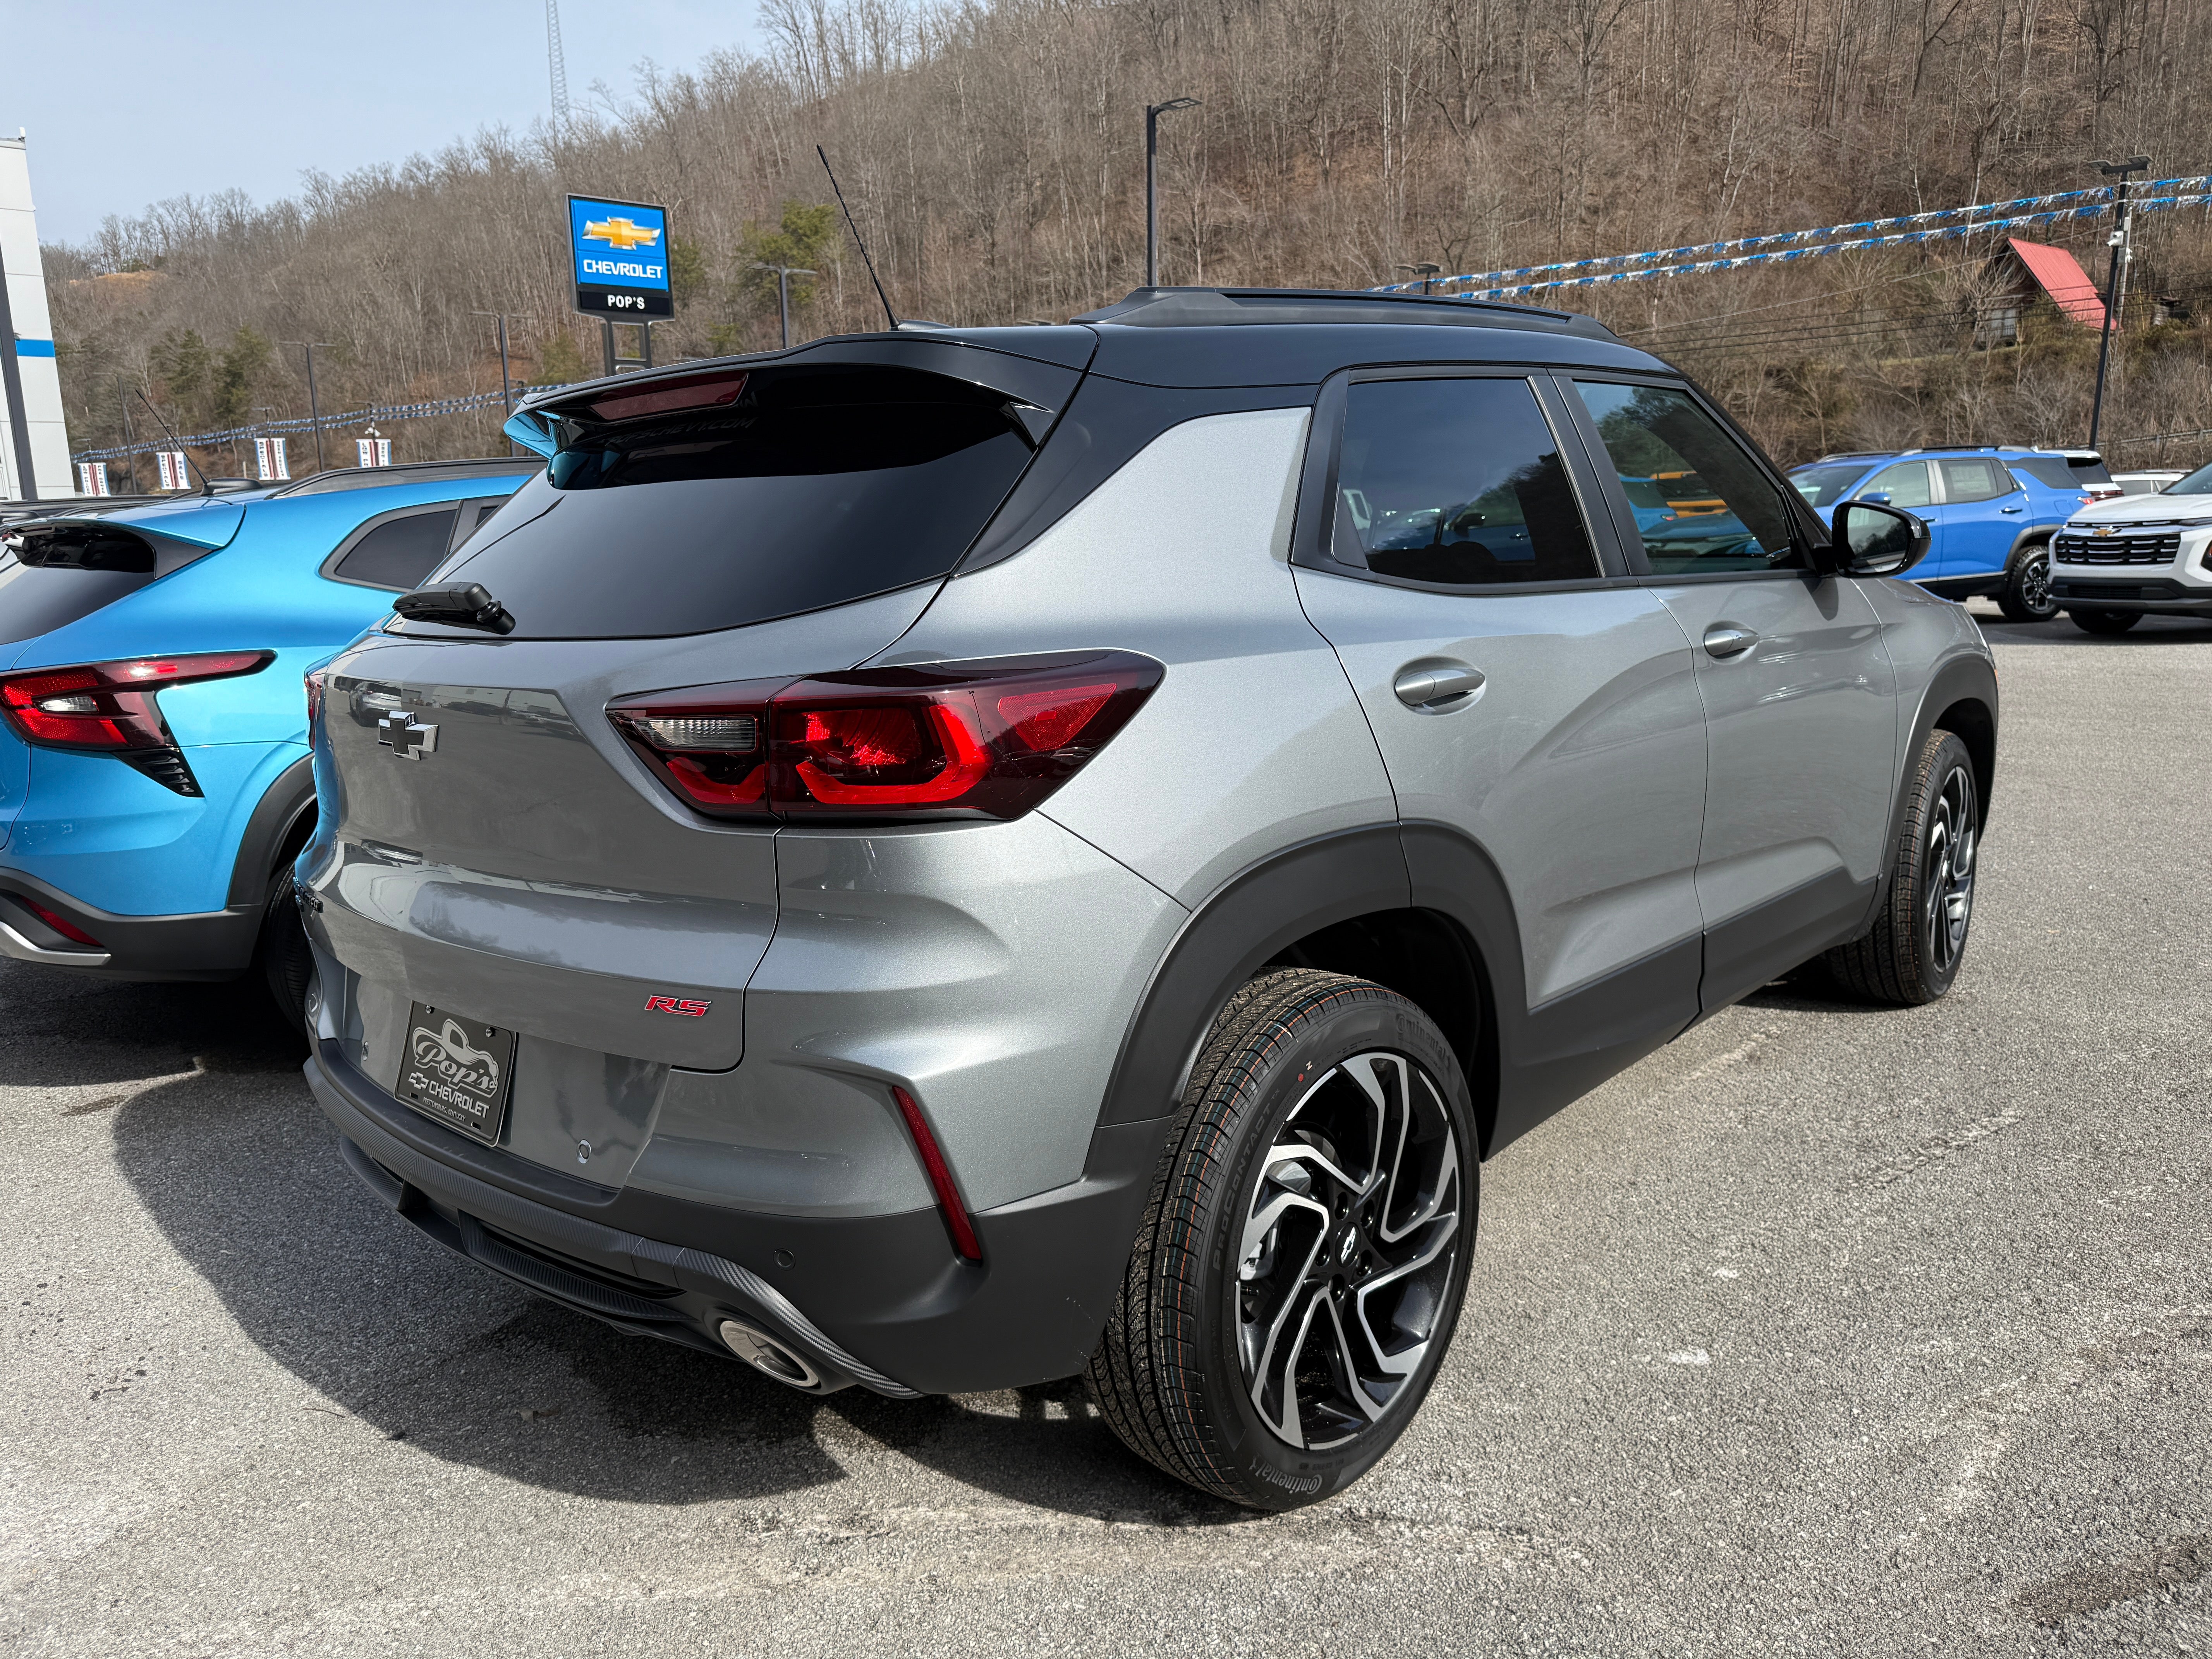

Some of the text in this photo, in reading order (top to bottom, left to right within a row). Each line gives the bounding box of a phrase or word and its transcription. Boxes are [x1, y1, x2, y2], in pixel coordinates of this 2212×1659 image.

[583, 259, 663, 279] CHEVROLET
[607, 294, 645, 309] POP'S
[161, 455, 170, 487] SPECIALS
[259, 441, 268, 477] SPECIALS
[644, 994, 712, 1017] RS
[1395, 1013, 1446, 1061] Continental
[417, 1041, 491, 1092] Pop's
[422, 1097, 466, 1121] PRESTONSBURG, KENTUCKY
[429, 1081, 489, 1118] CHEVROLET
[1255, 1462, 1323, 1495] Continental
